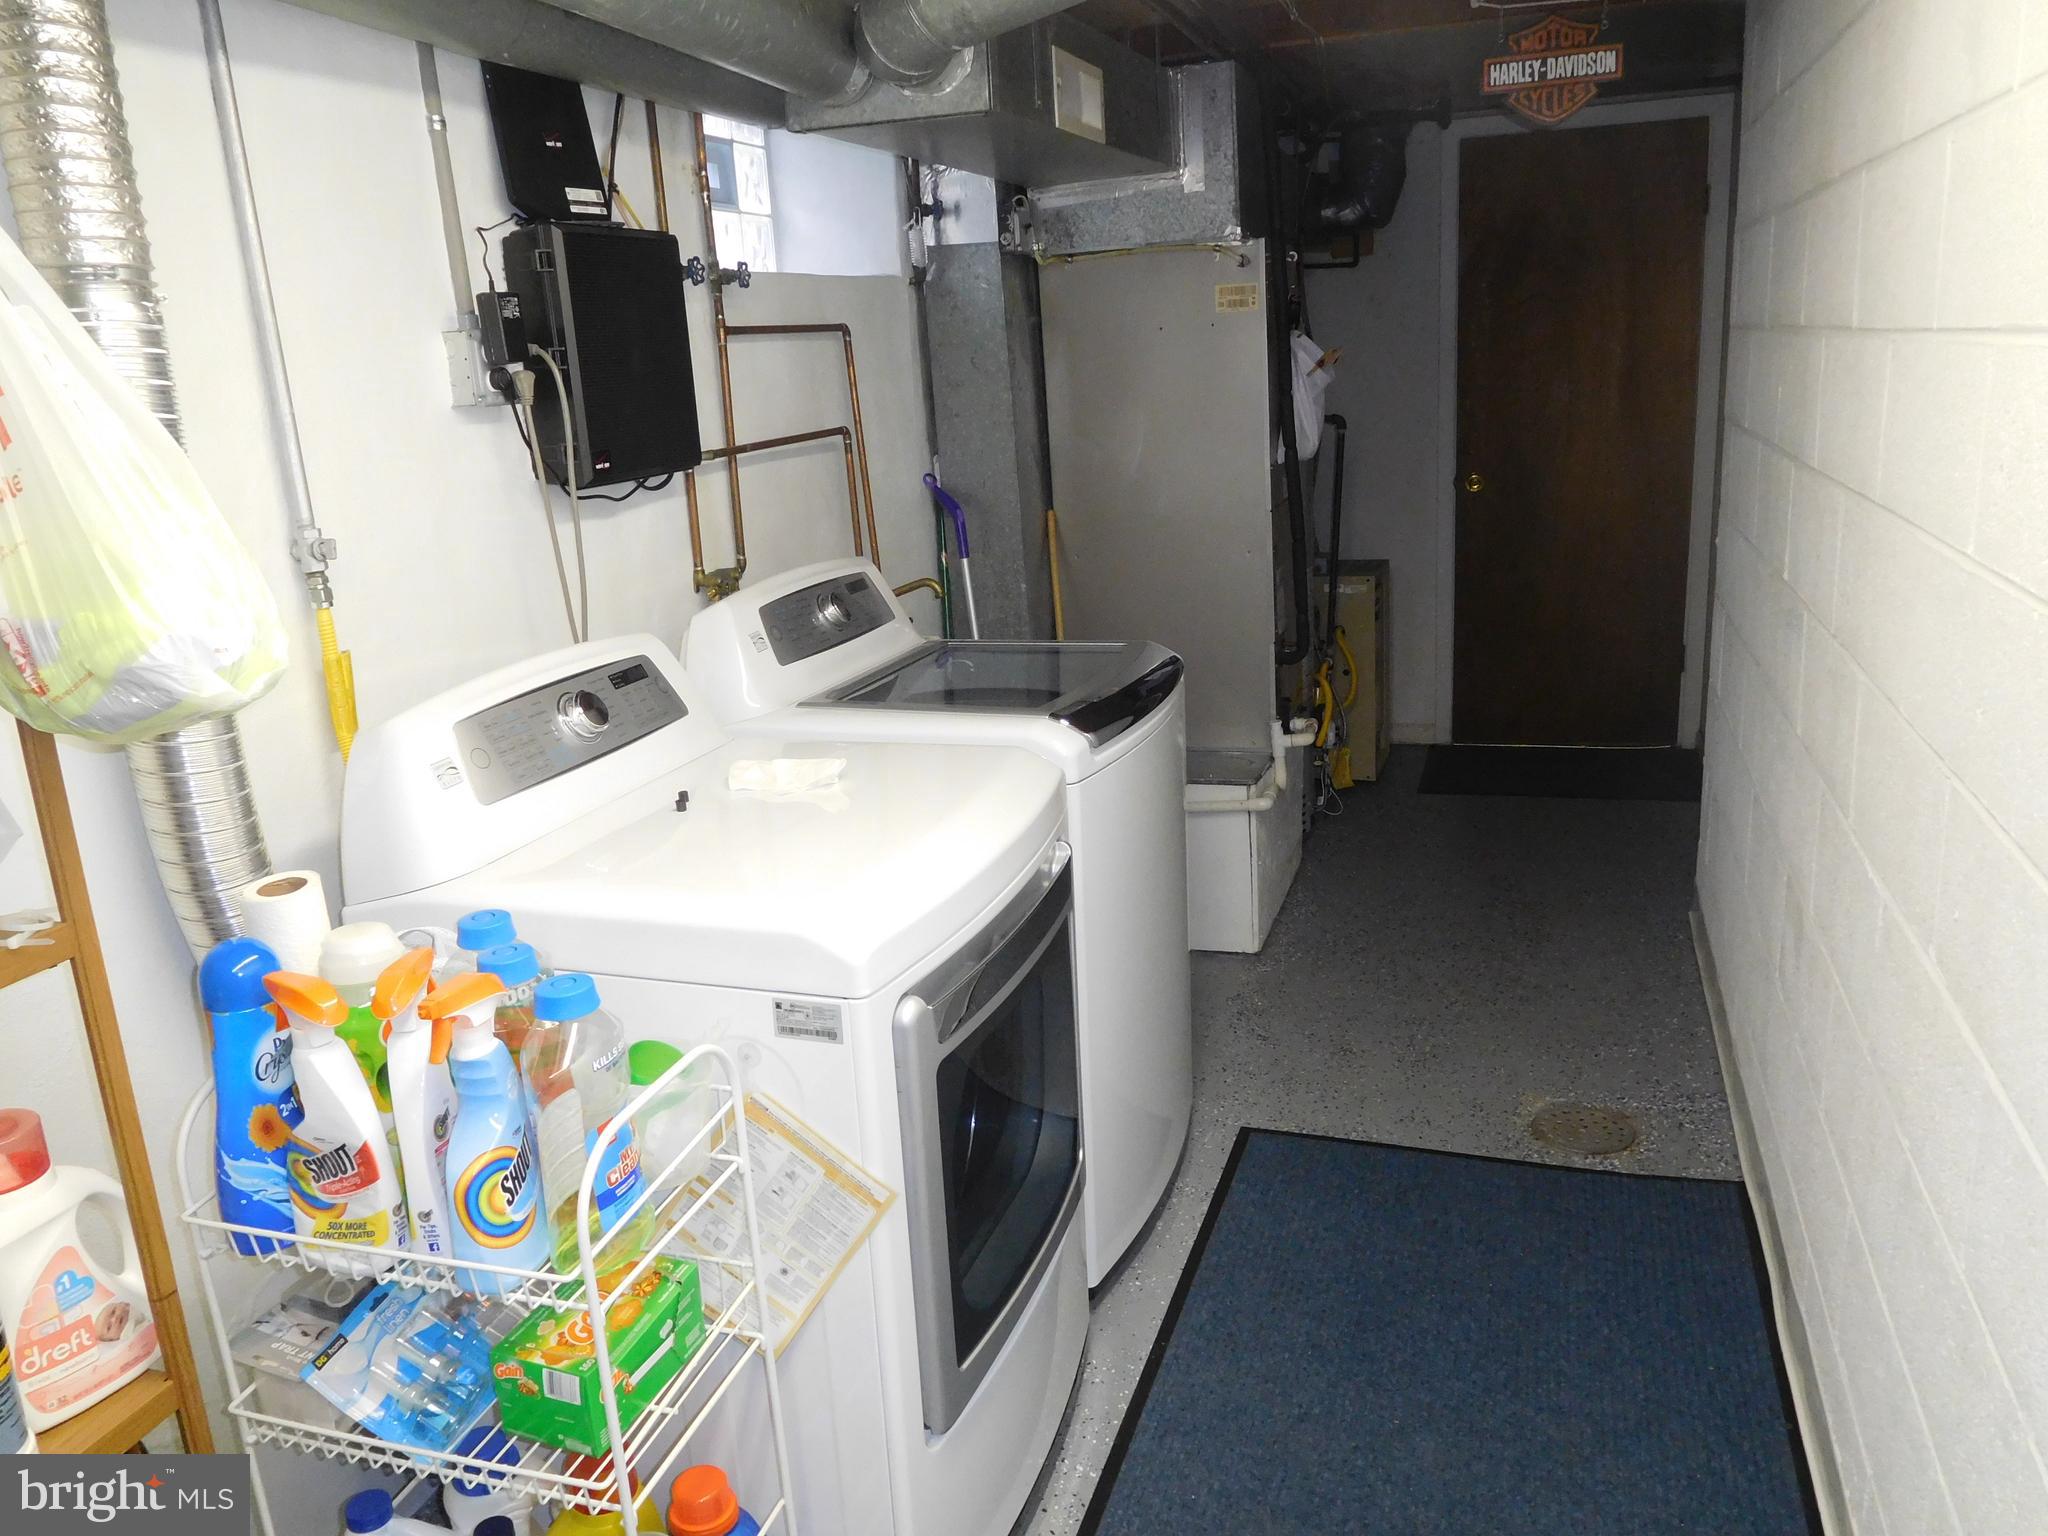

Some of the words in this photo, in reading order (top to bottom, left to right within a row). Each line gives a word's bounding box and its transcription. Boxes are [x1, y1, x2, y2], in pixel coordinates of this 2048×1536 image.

[1520, 23, 1588, 51] MOTOR
[1490, 50, 1617, 86] HARLEY-DAVIDSON
[1519, 83, 1586, 116] CYCLES
[592, 1046, 619, 1072] KILLS
[302, 1143, 356, 1185] SHOUT
[501, 1128, 532, 1208] SHOU
[313, 1230, 376, 1240] CONCENTRATED
[327, 1221, 344, 1231] 50X
[344, 1221, 367, 1231] MORE
[20, 1328, 93, 1374] dreft
[315, 1354, 329, 1368] DG
[327, 1336, 346, 1356] home
[493, 1362, 525, 1379] Gain
